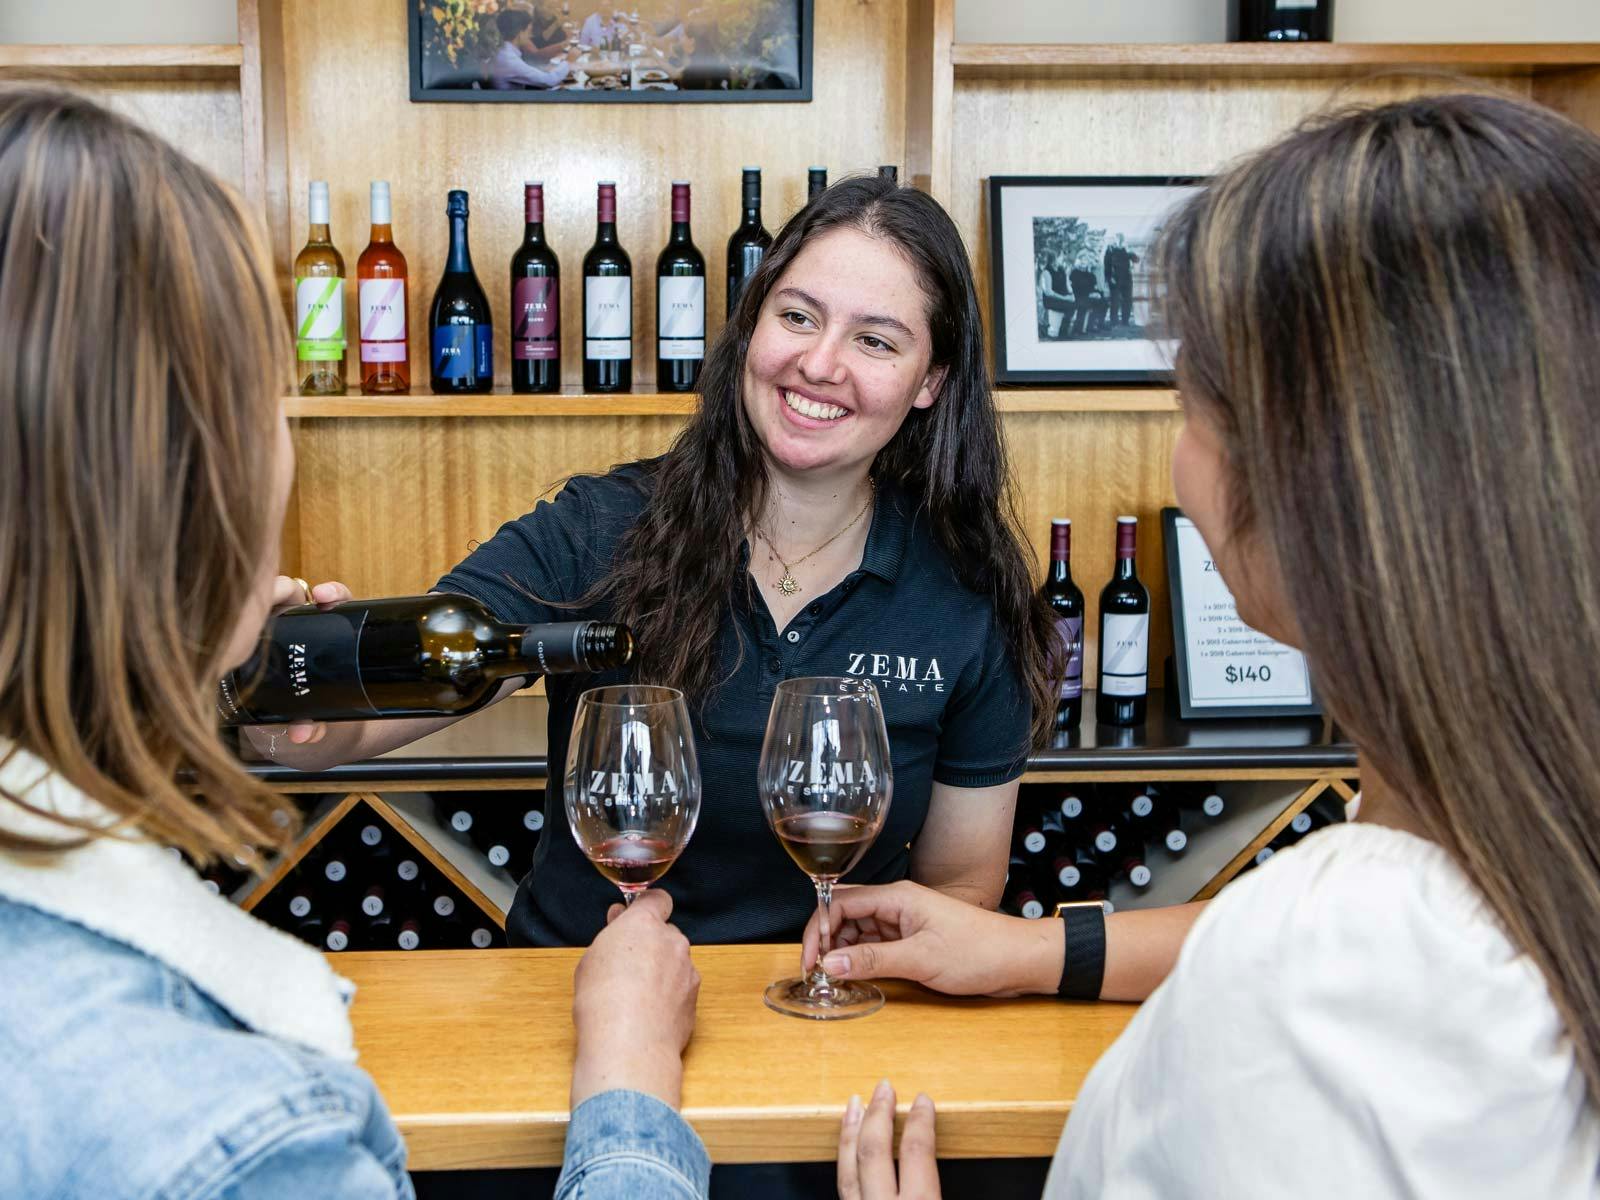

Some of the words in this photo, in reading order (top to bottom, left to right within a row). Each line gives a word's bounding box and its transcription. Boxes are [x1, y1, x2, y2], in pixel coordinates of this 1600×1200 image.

[293, 643, 311, 696] ZEMA
[845, 652, 945, 681] ZEMA
[1225, 663, 1271, 684] $140
[839, 679, 945, 693] ESTATE
[590, 770, 677, 795] ZEMA
[788, 759, 875, 784] ZEMA
